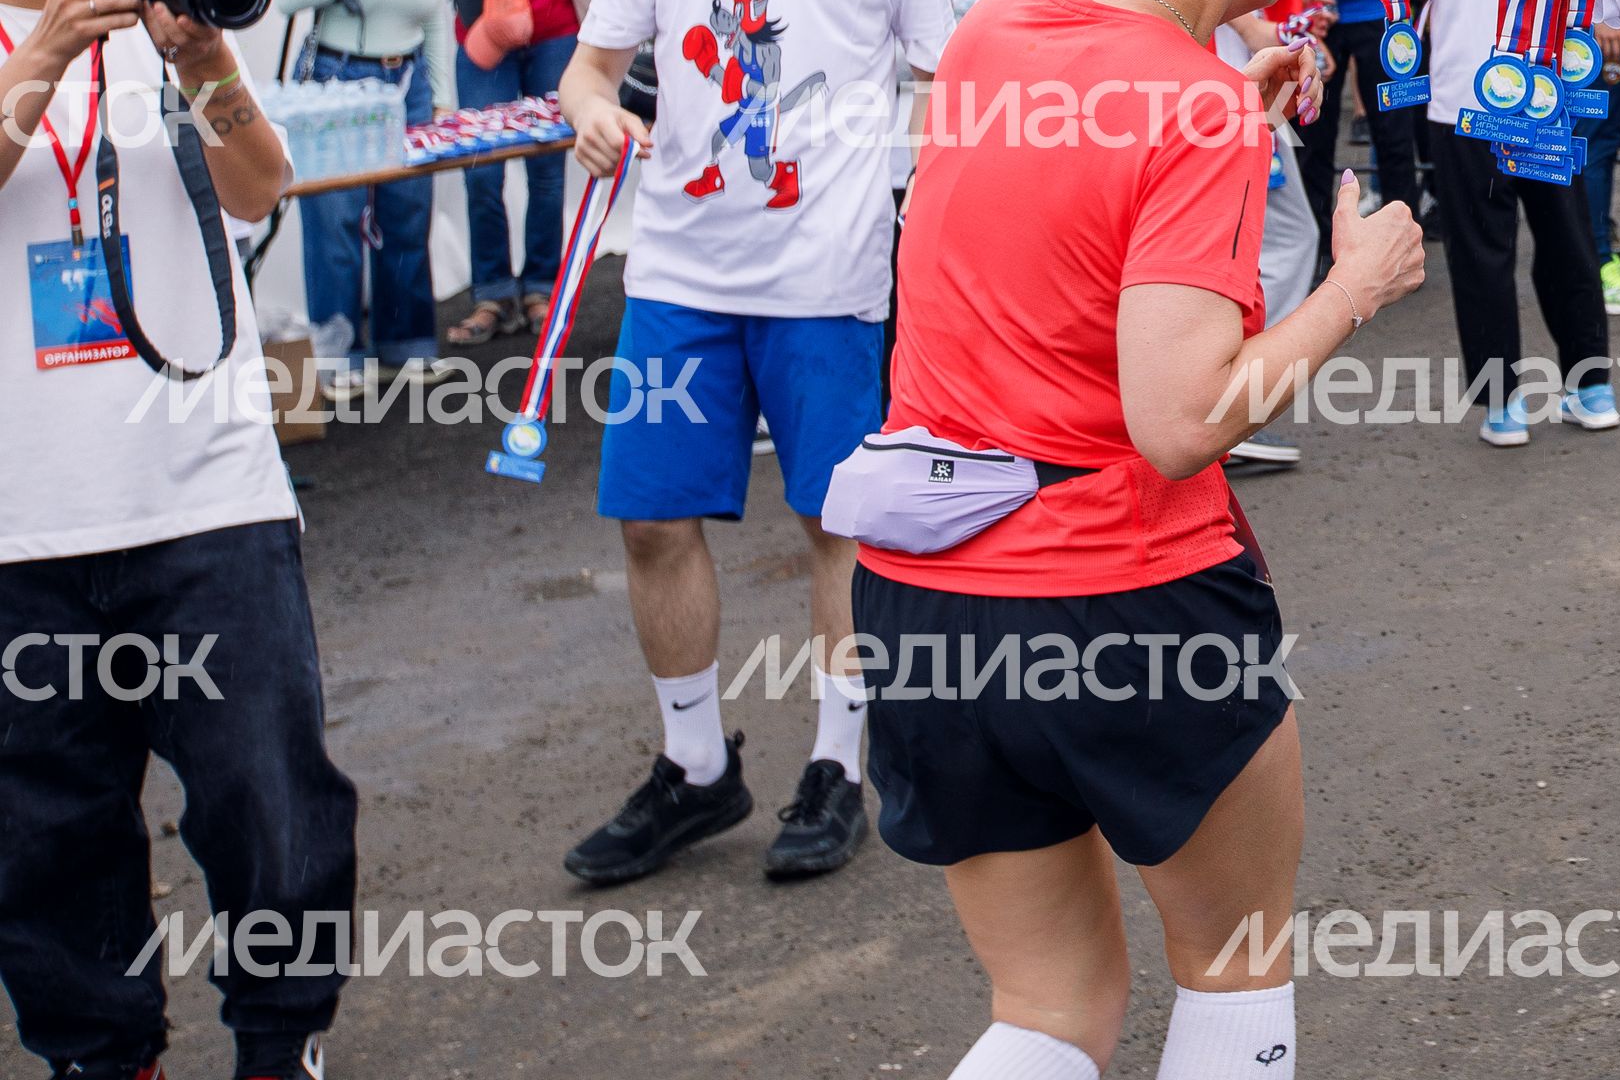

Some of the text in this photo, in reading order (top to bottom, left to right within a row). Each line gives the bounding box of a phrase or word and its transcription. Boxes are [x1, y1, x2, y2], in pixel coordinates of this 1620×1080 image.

[1475, 121, 1499, 131] ИГРЫ
[1477, 113, 1530, 130] ВСЕМИРНЫЕ
[1473, 128, 1529, 144] ДРУЖБЫ 2024
[1551, 144, 1567, 152] 2024
[1544, 154, 1560, 162] 2024
[1518, 167, 1567, 182] ДРУЖБЫ 2024
[44, 345, 130, 366] ОРГАНИЗАТОР
